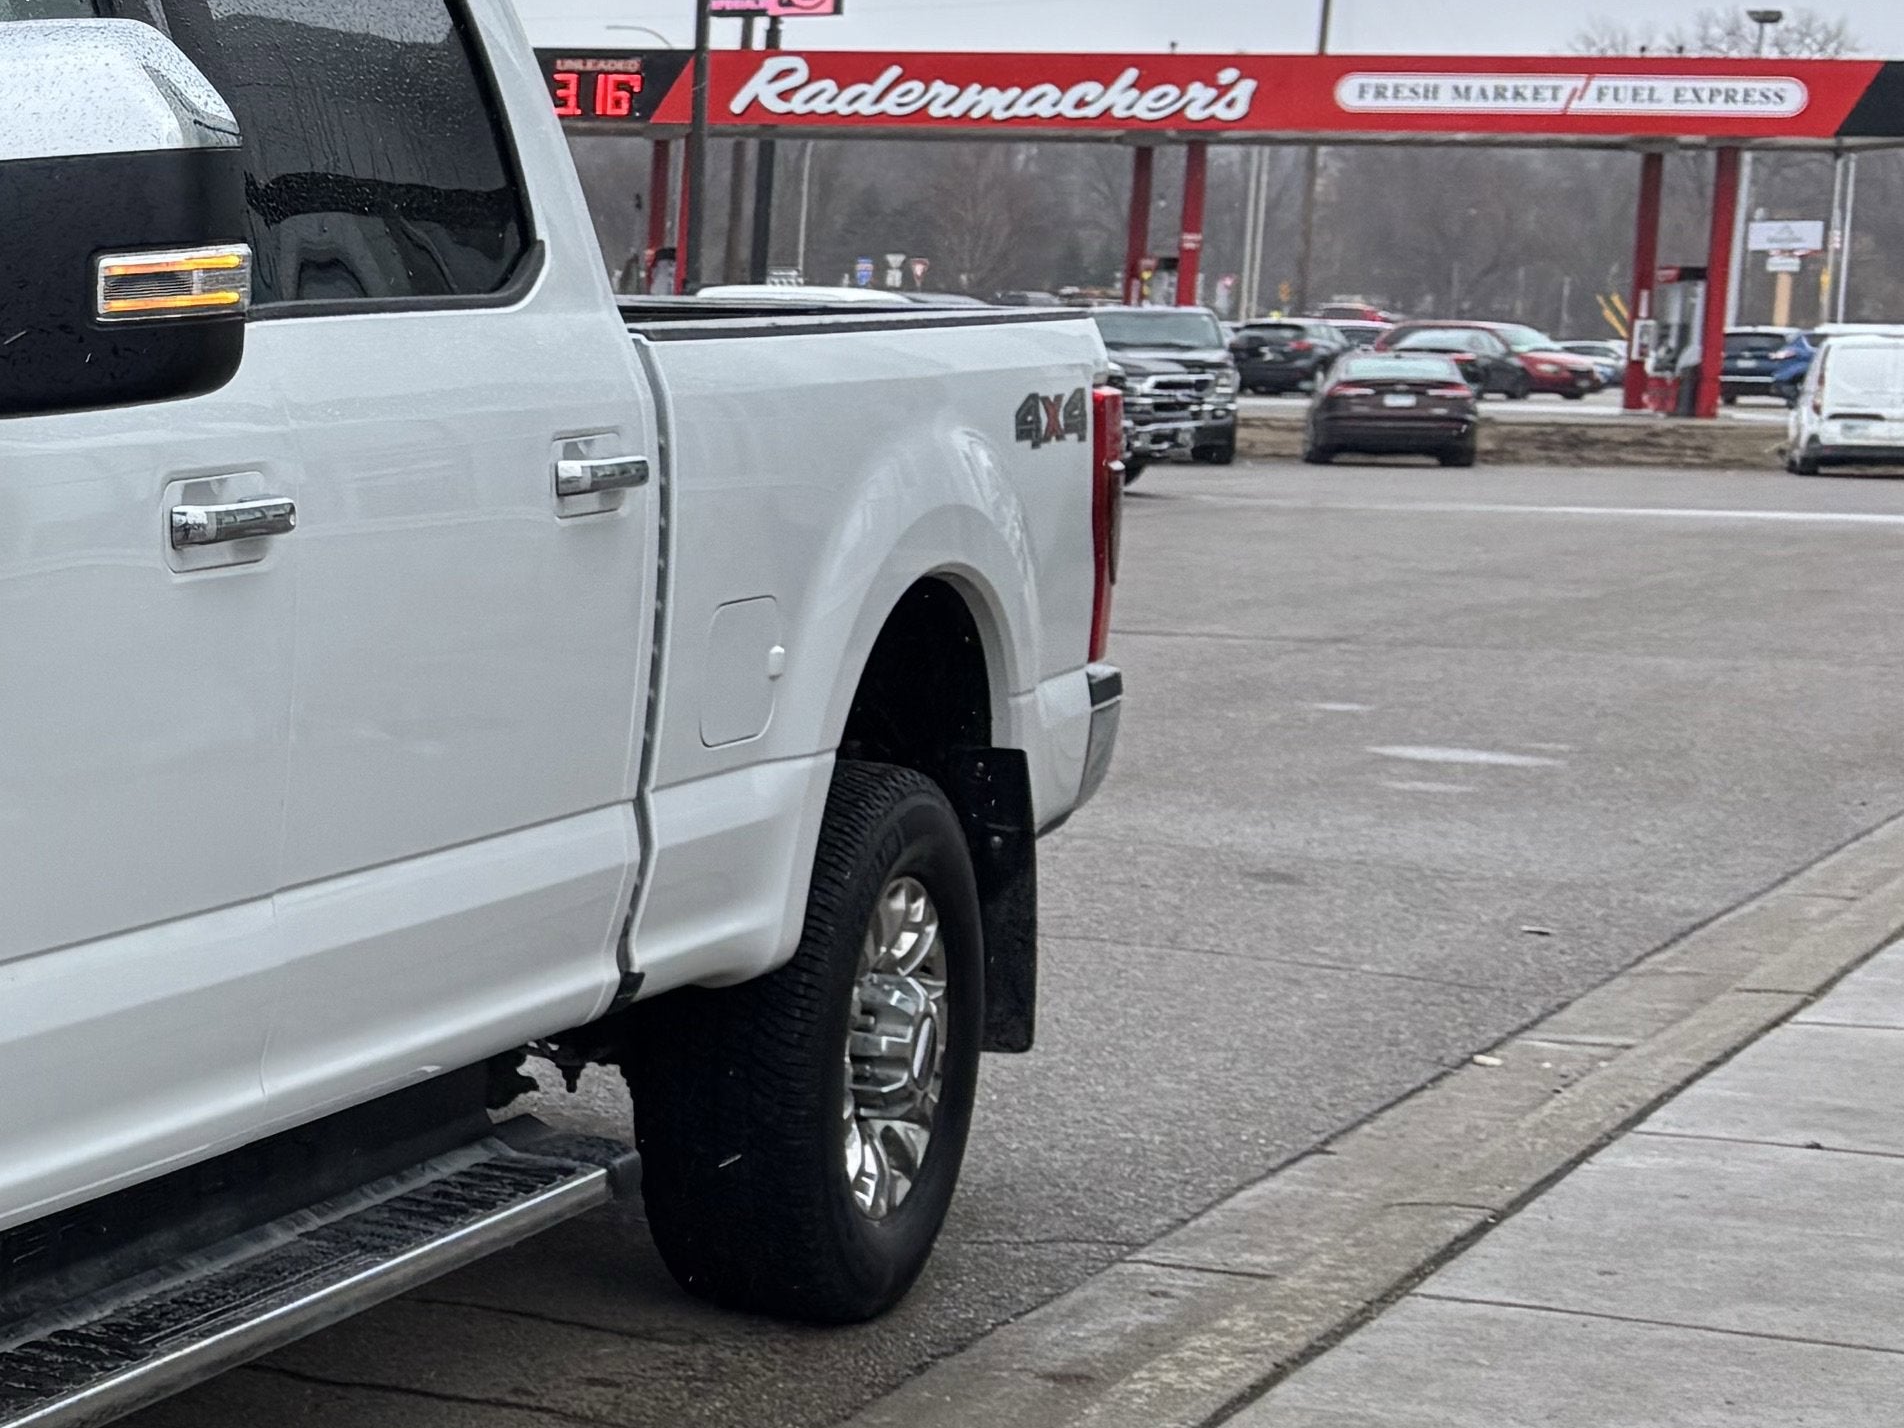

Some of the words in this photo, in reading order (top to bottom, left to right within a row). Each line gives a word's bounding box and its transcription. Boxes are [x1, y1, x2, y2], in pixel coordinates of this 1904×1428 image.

[555, 58, 641, 71] UNLEADED
[730, 56, 1258, 121] Radermacher's
[1357, 82, 1440, 102] FRESH
[1450, 83, 1564, 103] MARKET
[1596, 86, 1662, 104] FUEL
[1673, 86, 1787, 106] EXPRESS
